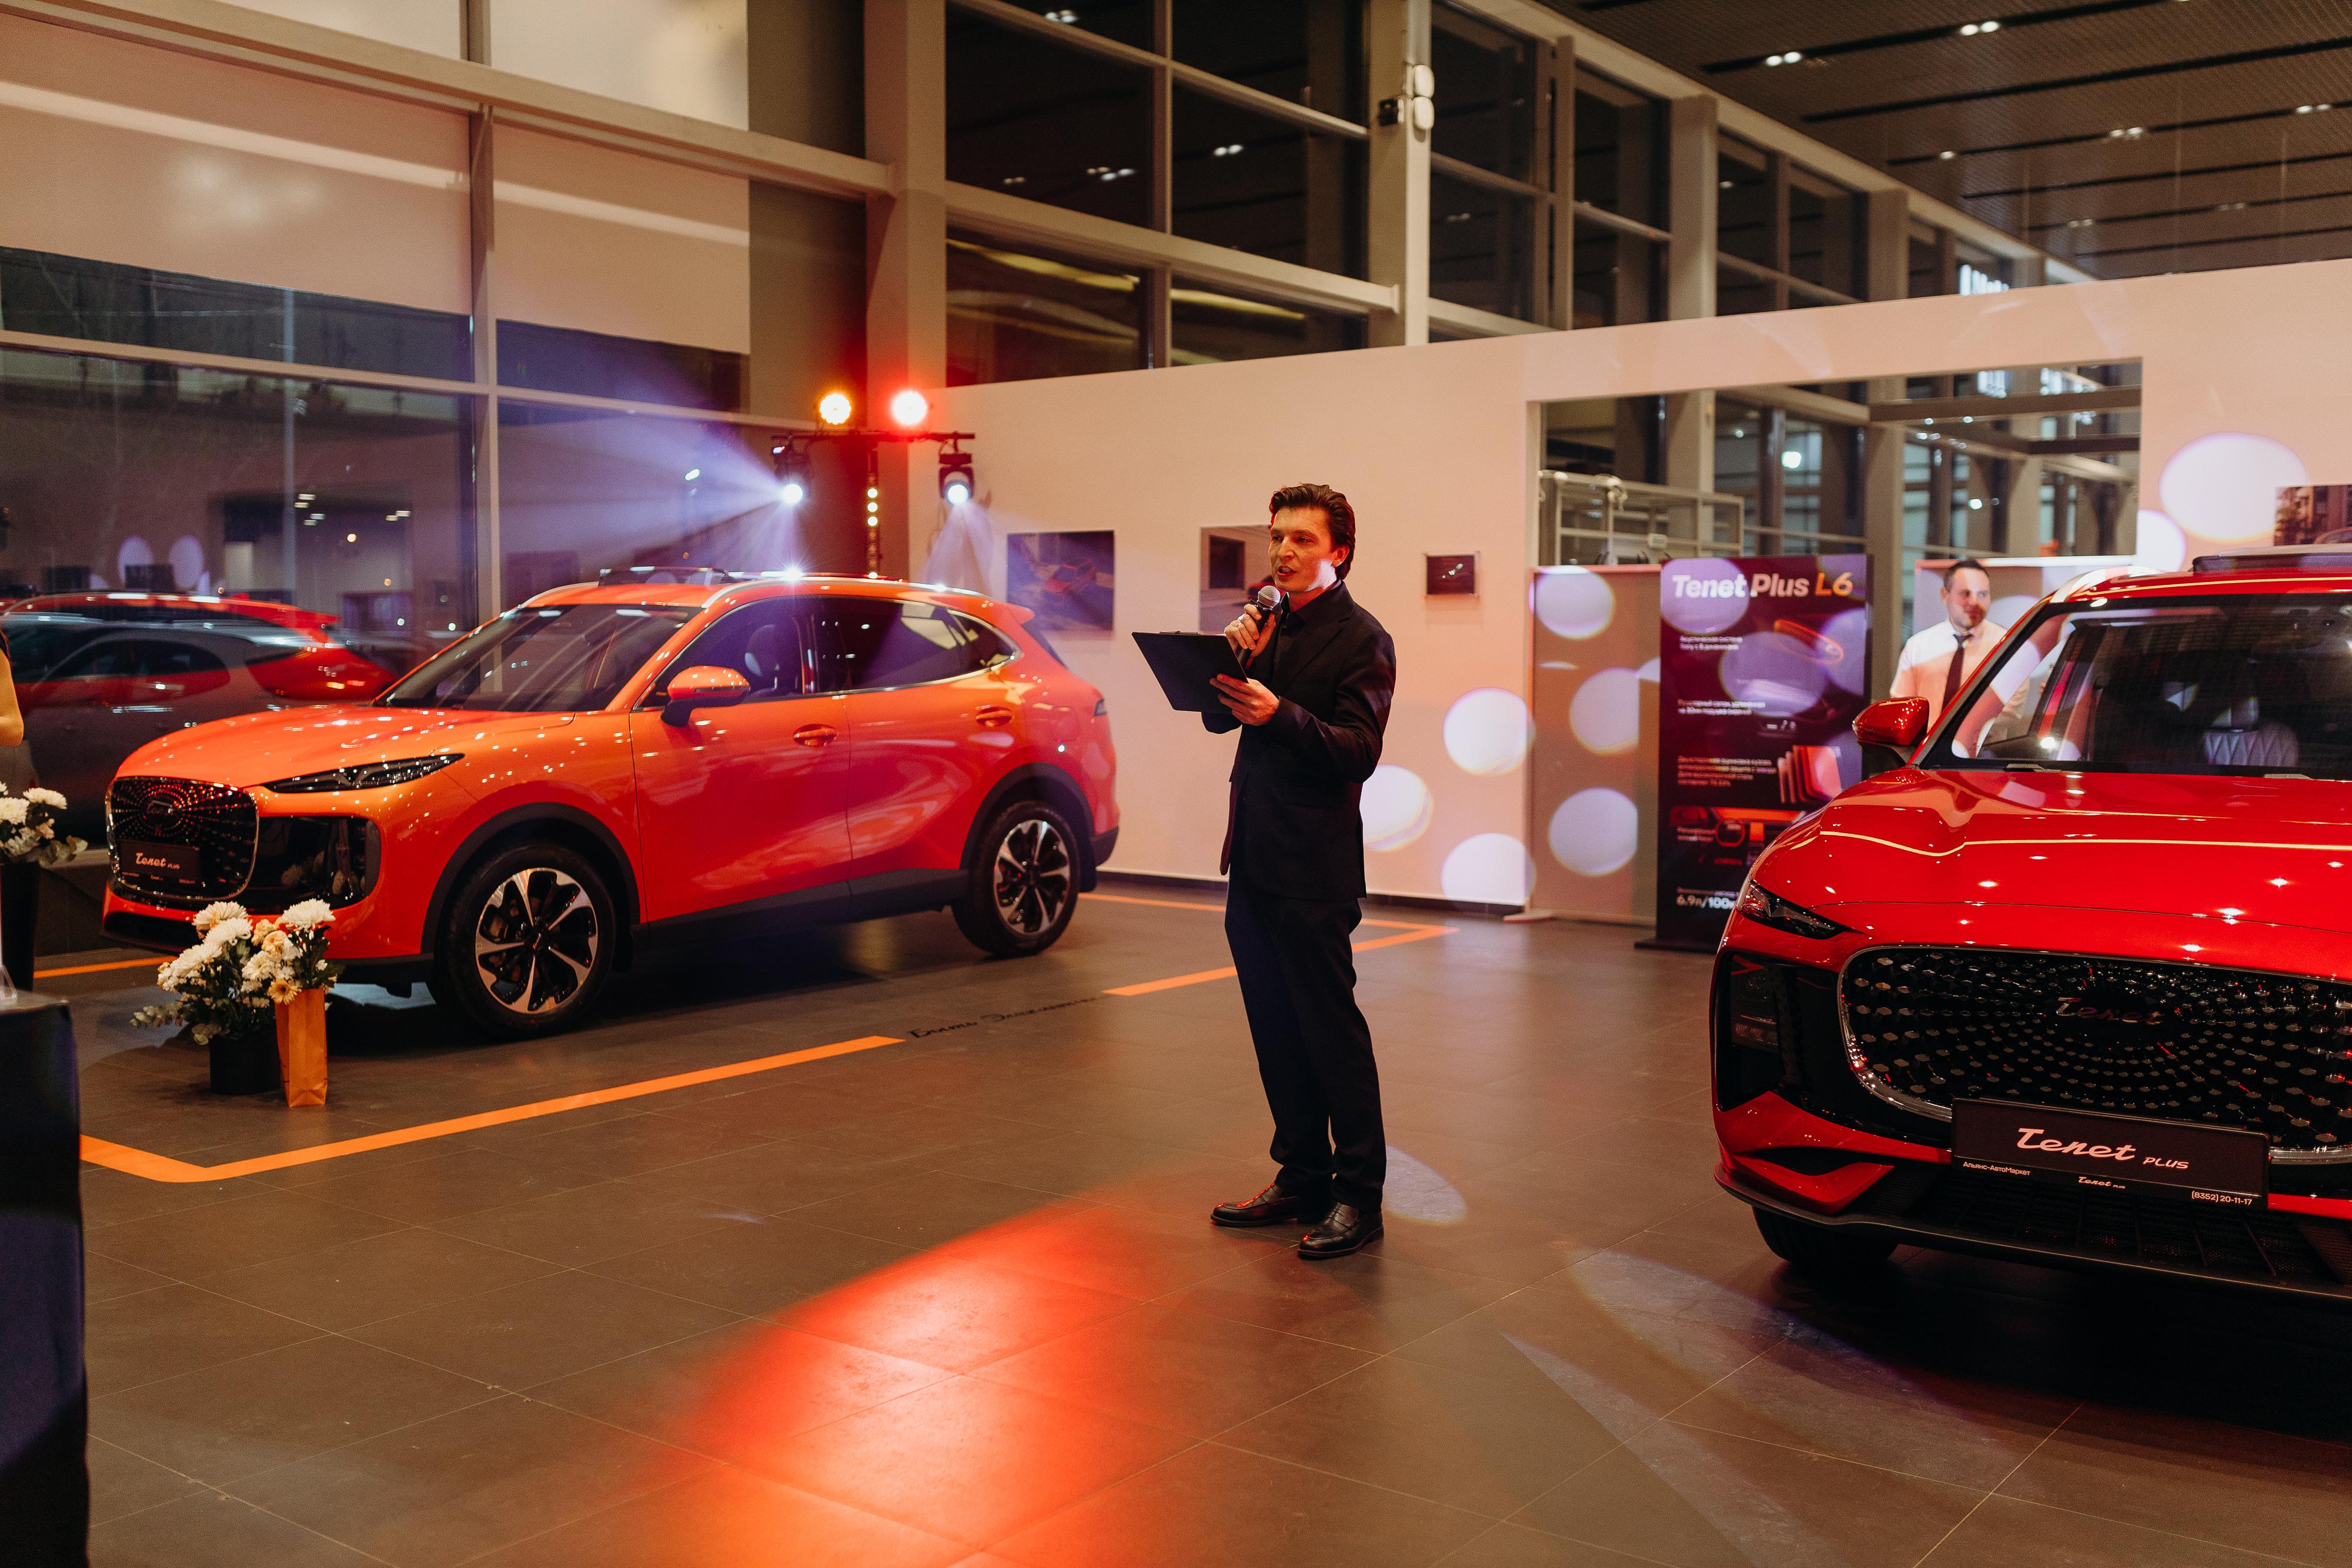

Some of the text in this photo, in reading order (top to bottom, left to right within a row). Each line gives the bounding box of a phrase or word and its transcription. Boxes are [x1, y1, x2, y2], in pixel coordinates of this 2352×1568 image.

[1672, 571, 1853, 598] Tenet Plus L6
[136, 852, 166, 867] Tenet
[2017, 1128, 2189, 1169] Tenet PLUS
[1963, 1161, 2031, 1176] Альянс-АвтоМаркет
[2078, 1176, 2112, 1188] Tenet
[2192, 1191, 2253, 1205] (8352) 20-11-17
